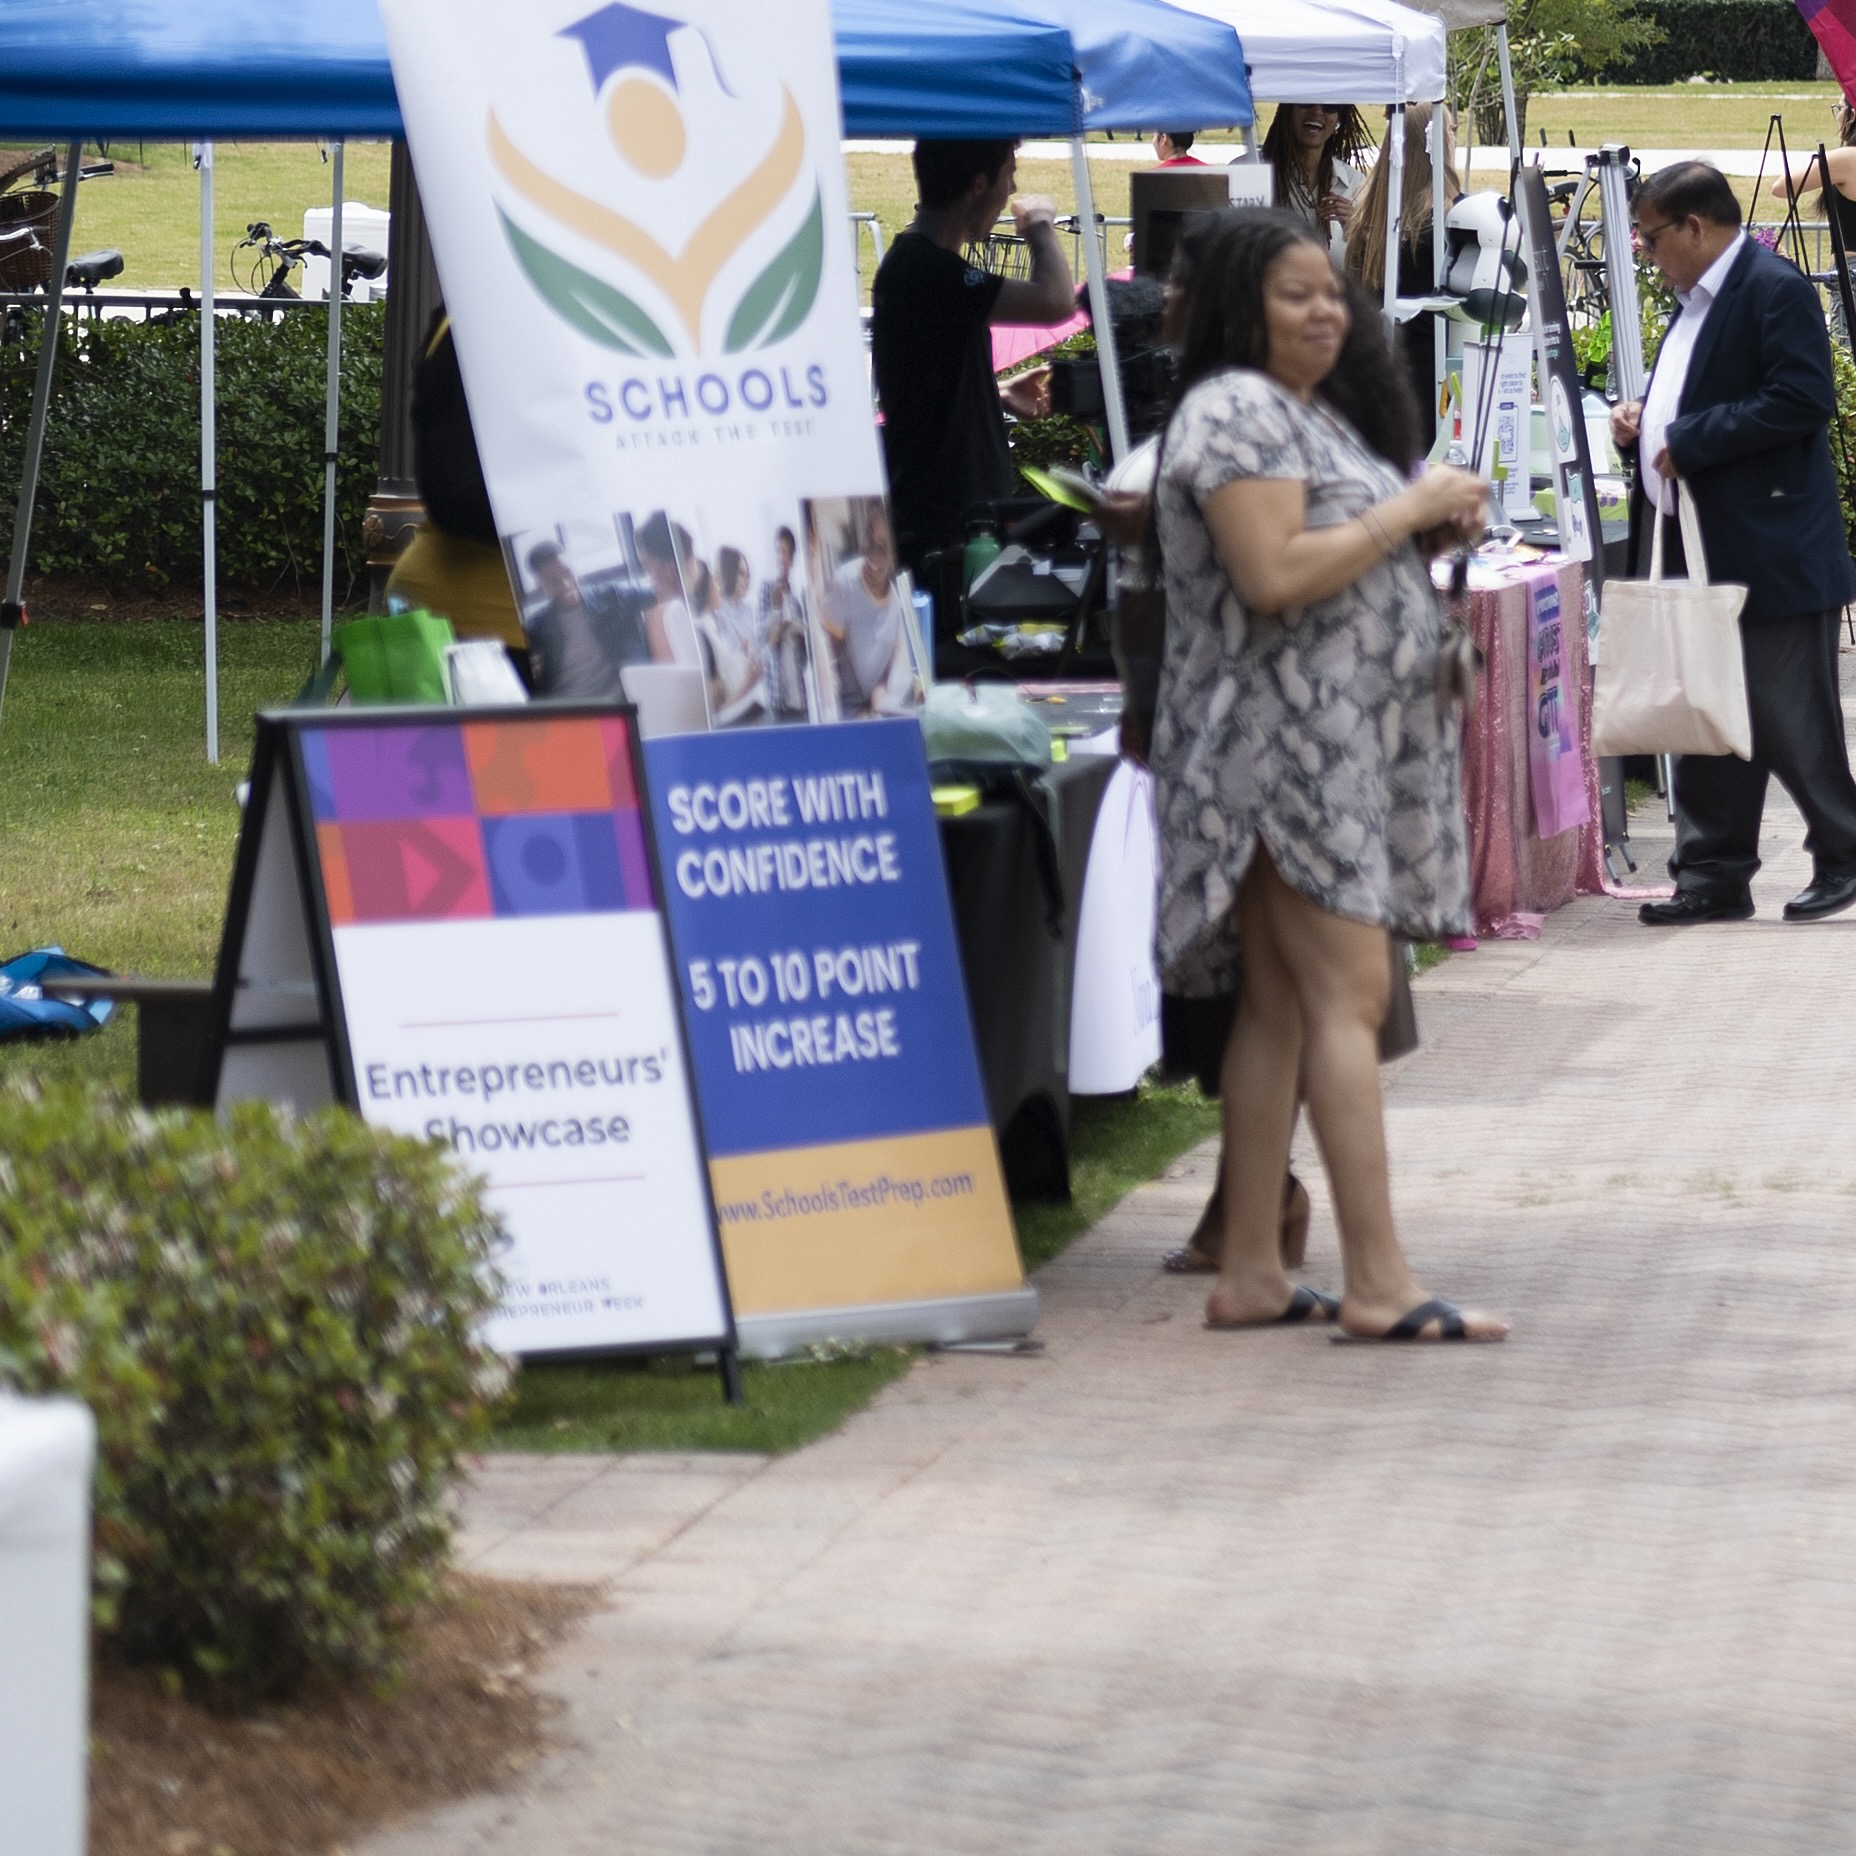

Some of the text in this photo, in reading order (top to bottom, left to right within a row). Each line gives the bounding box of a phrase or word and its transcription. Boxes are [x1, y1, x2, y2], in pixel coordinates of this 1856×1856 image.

[584, 363, 830, 425] SCHOOLS
[614, 417, 816, 452] ATTACK THE TEST
[666, 771, 888, 836] SCORE WITH
[675, 831, 901, 900] CONFIDENCE
[689, 940, 921, 1010] 5 TO 10 POINT
[729, 1011, 900, 1073] INCREASE
[366, 1047, 668, 1105] Entrepreneurs'
[423, 1110, 632, 1157] Showcase
